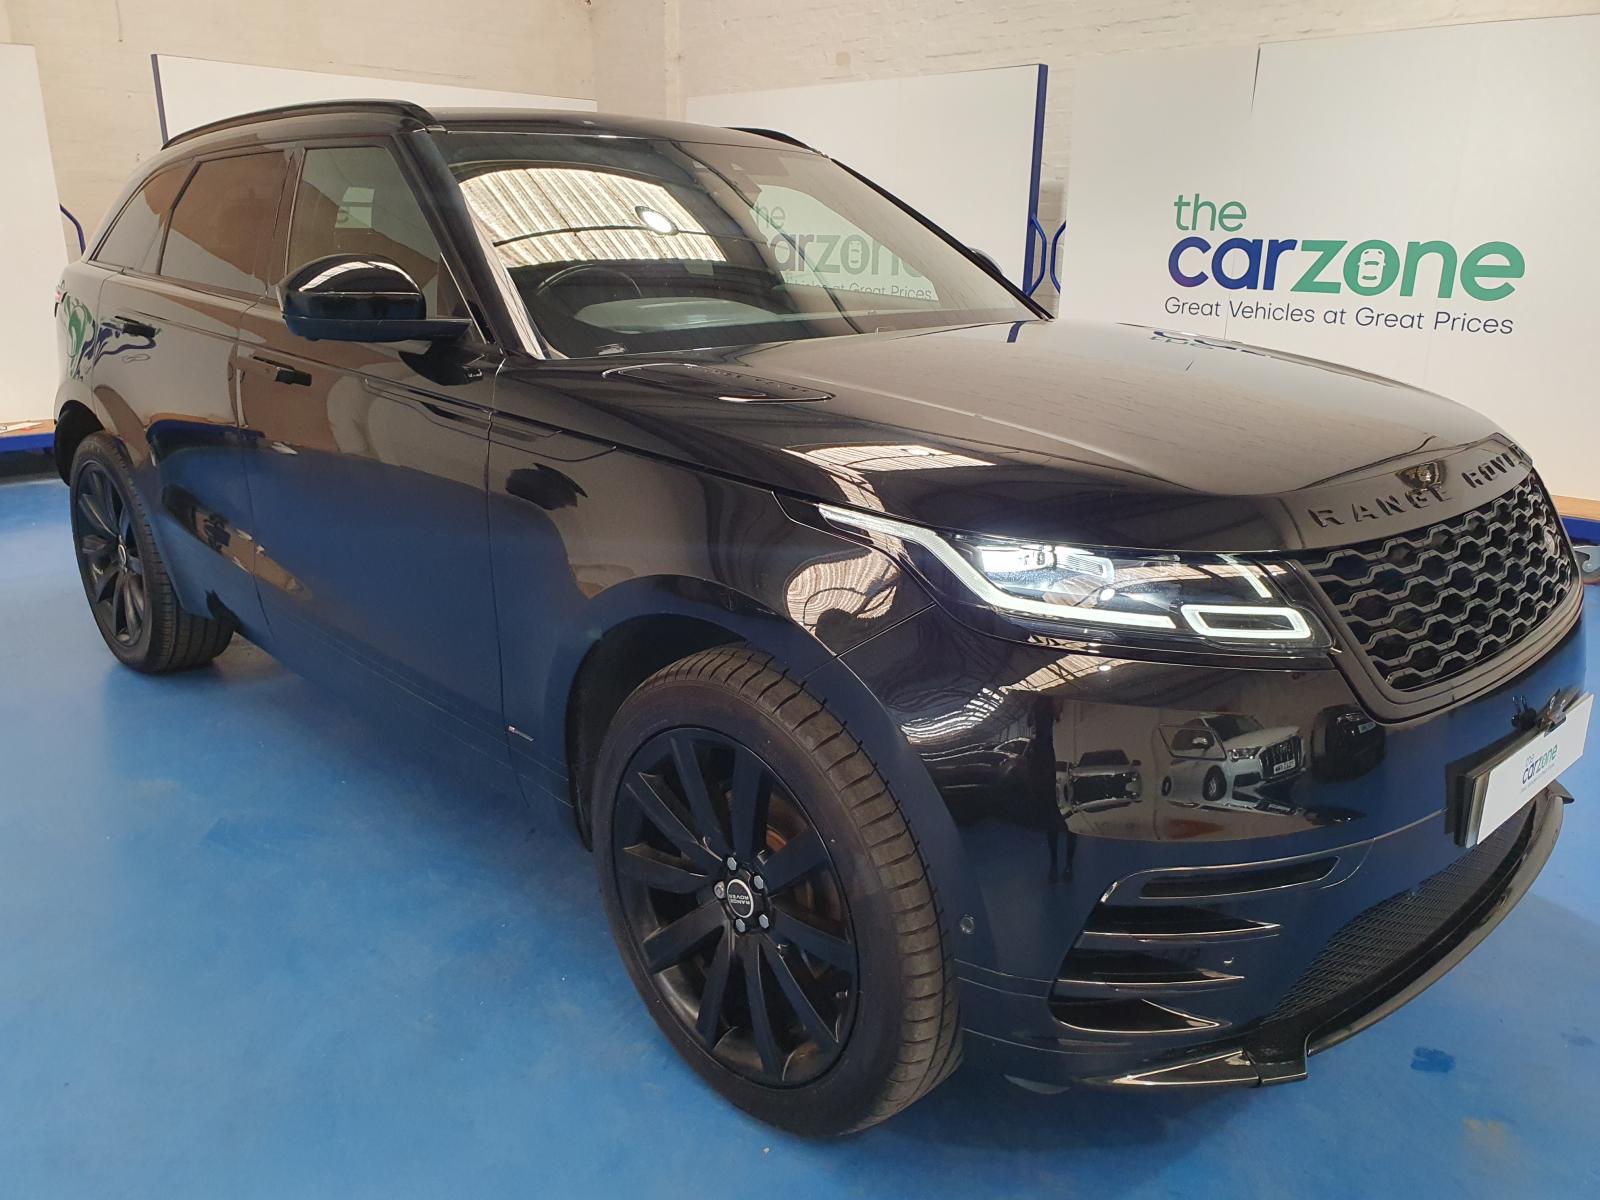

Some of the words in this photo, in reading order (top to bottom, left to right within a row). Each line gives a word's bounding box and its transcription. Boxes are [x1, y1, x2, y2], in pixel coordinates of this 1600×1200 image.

[1173, 193, 1247, 233] the
[1168, 236, 1526, 302] carzone
[891, 285, 932, 300] Prices
[1164, 296, 1221, 319] Great
[1229, 300, 1315, 324] Vehicles
[1323, 307, 1346, 325] at
[1355, 307, 1425, 330] Great
[1434, 311, 1514, 335] Prices
[1307, 485, 1451, 528] RANGE
[1522, 744, 1558, 785] carzone
